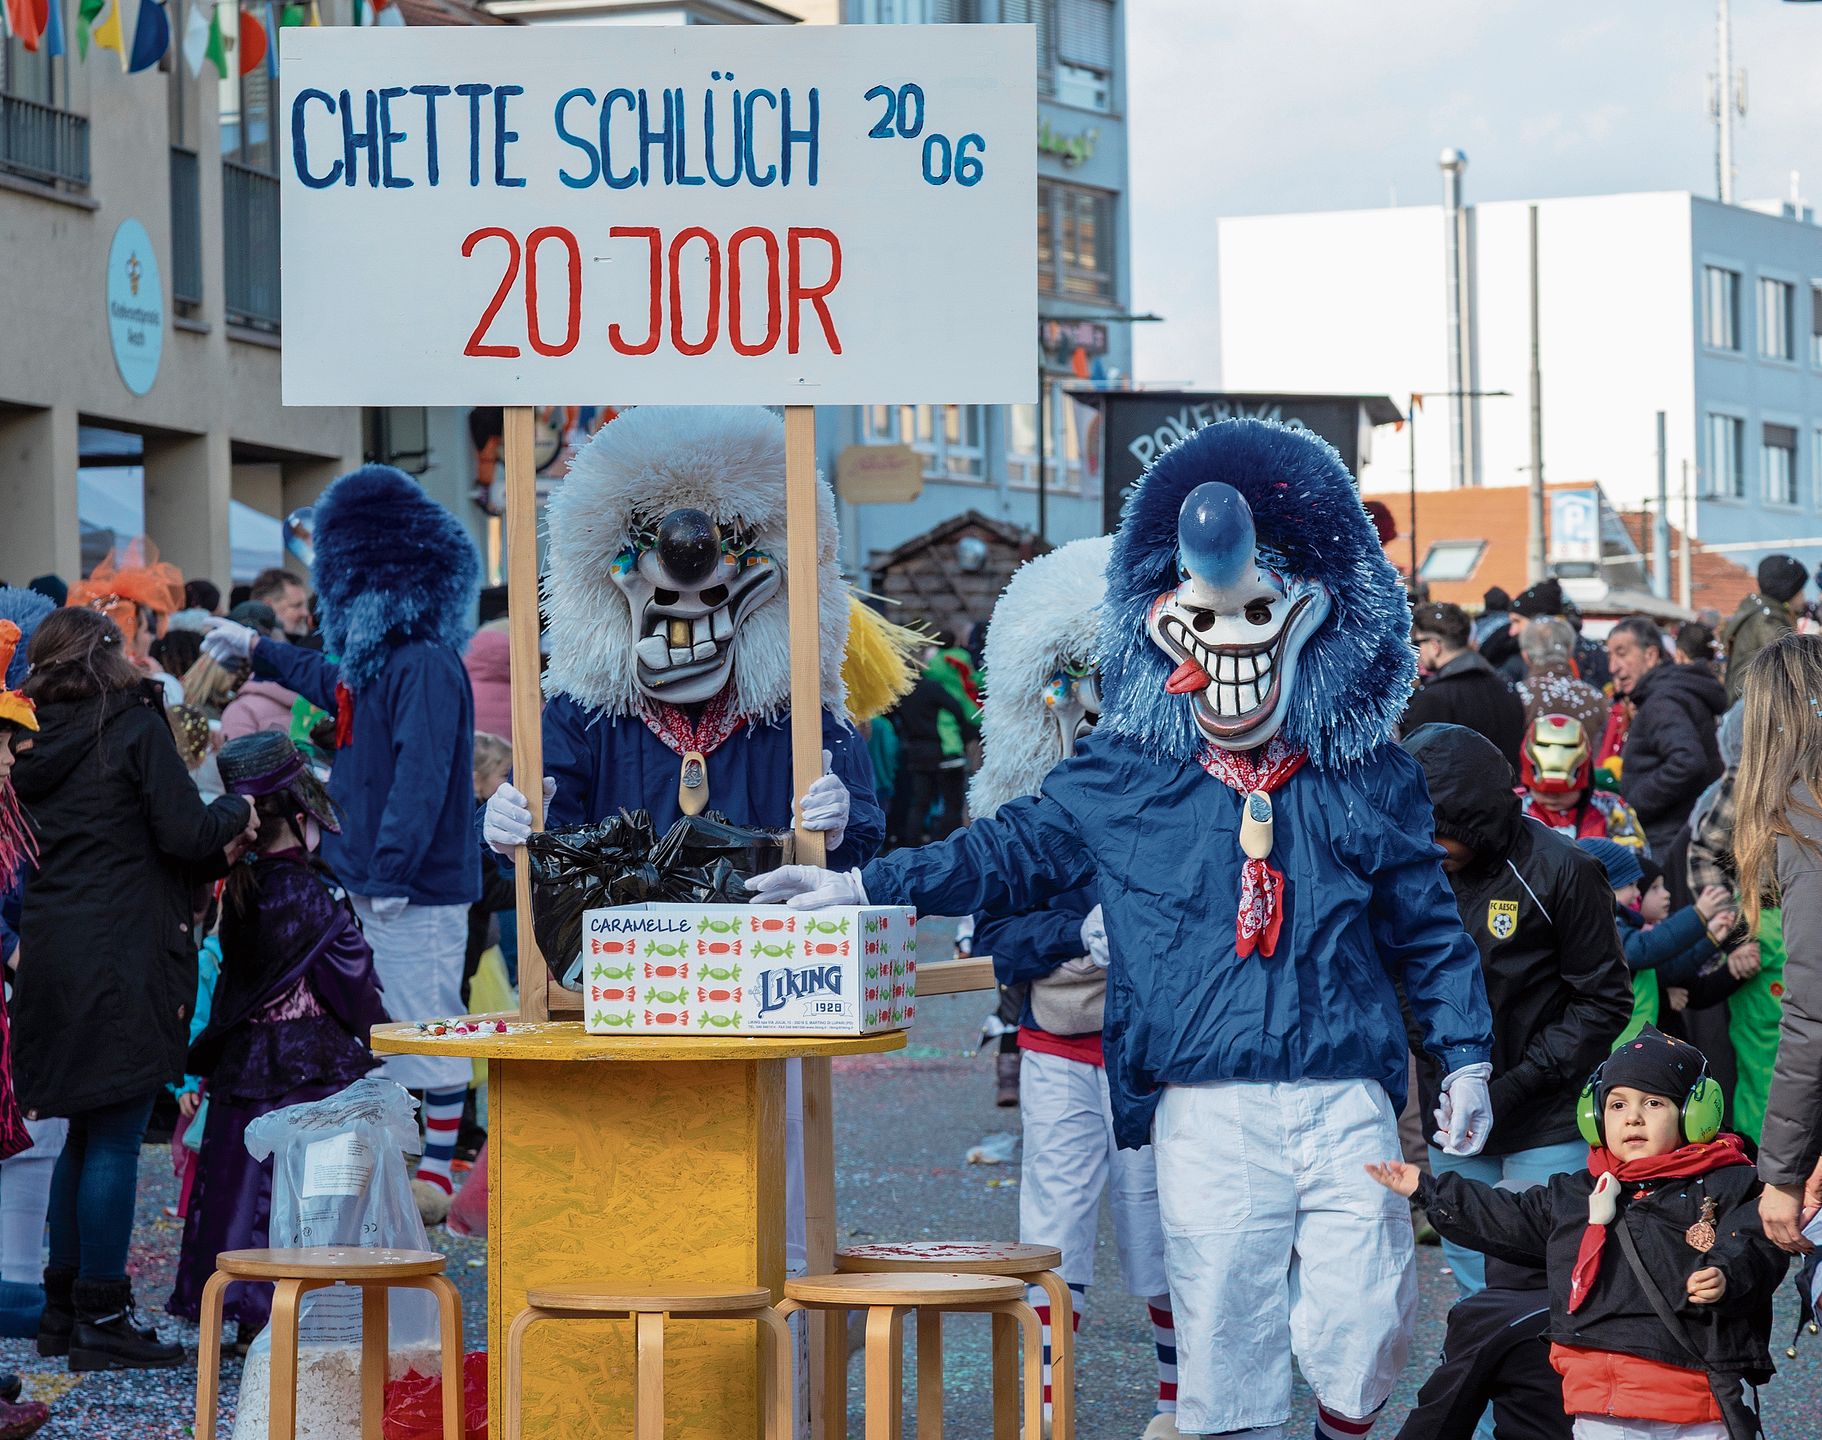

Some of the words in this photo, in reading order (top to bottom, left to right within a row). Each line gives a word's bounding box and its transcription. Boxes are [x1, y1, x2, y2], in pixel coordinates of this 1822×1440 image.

[292, 83, 526, 189] CHETTE
[555, 70, 819, 189] SCHLÜCH
[864, 83, 924, 138] 20
[922, 133, 986, 187] 06
[462, 227, 581, 358] 20
[608, 227, 842, 356] JOOR
[590, 918, 692, 933] CARAMELLE
[1490, 902, 1498, 910] FC
[1499, 903, 1517, 911] AESCH
